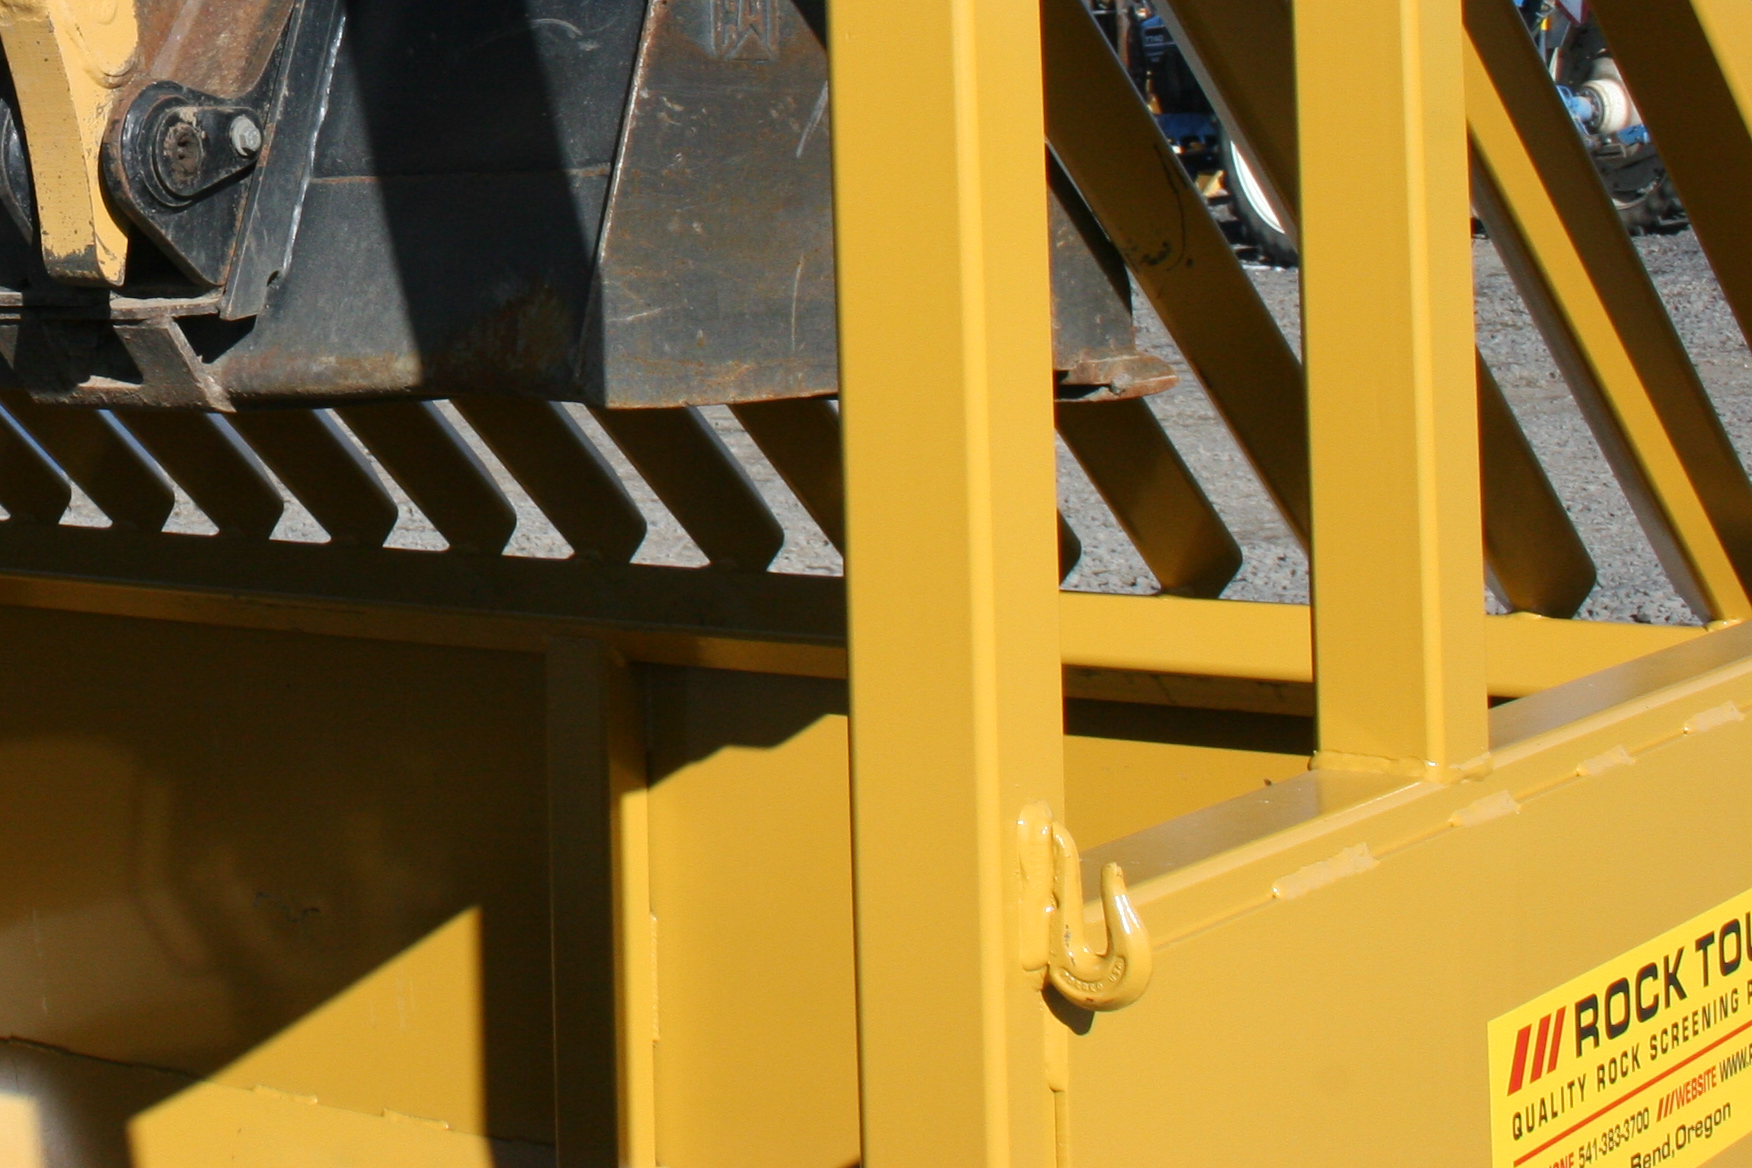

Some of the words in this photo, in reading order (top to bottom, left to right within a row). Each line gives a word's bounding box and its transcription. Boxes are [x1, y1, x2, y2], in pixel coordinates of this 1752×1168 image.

[1512, 1072, 1587, 1141] QUALITY
[1596, 1042, 1641, 1092] ROCK
[1649, 986, 1739, 1062] SCREENING
[1574, 946, 1687, 1058] ROCK
[1578, 1106, 1650, 1168] 541-383-3700
[1675, 1064, 1718, 1111] WEBSITE
[1718, 1041, 1752, 1083] WWW.
